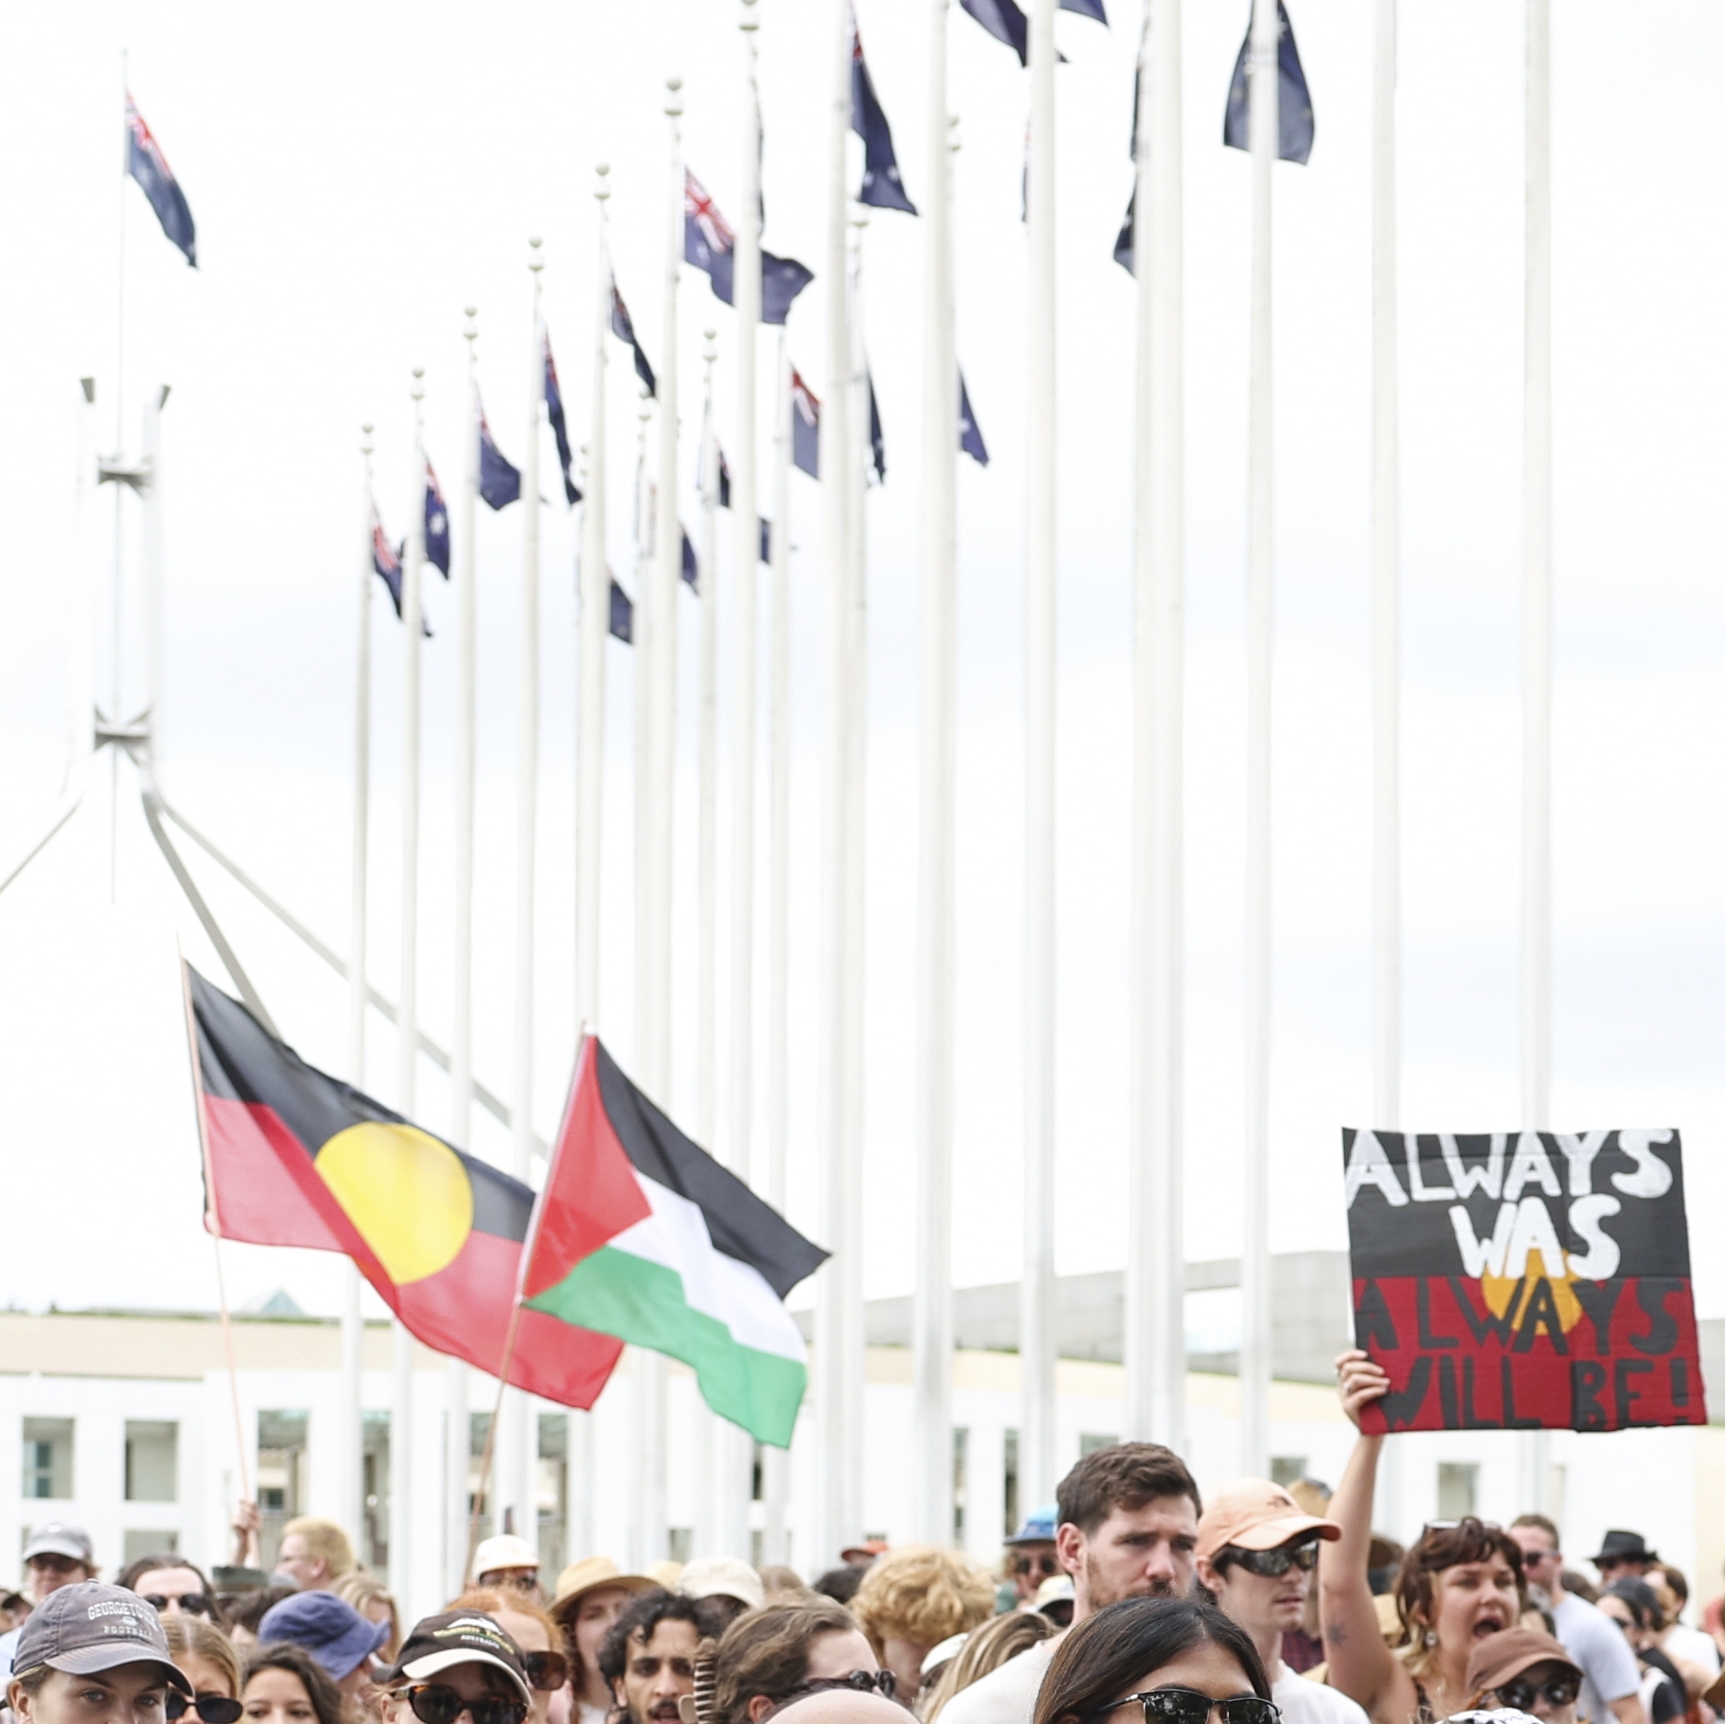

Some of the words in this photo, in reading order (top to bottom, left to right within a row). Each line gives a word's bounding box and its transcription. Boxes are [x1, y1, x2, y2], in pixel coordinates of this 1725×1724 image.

[1345, 1129, 1674, 1209] ALWAYS
[1449, 1194, 1622, 1280] WAS
[1354, 1277, 1686, 1356] ALWAYS
[1377, 1355, 1542, 1429] WILL
